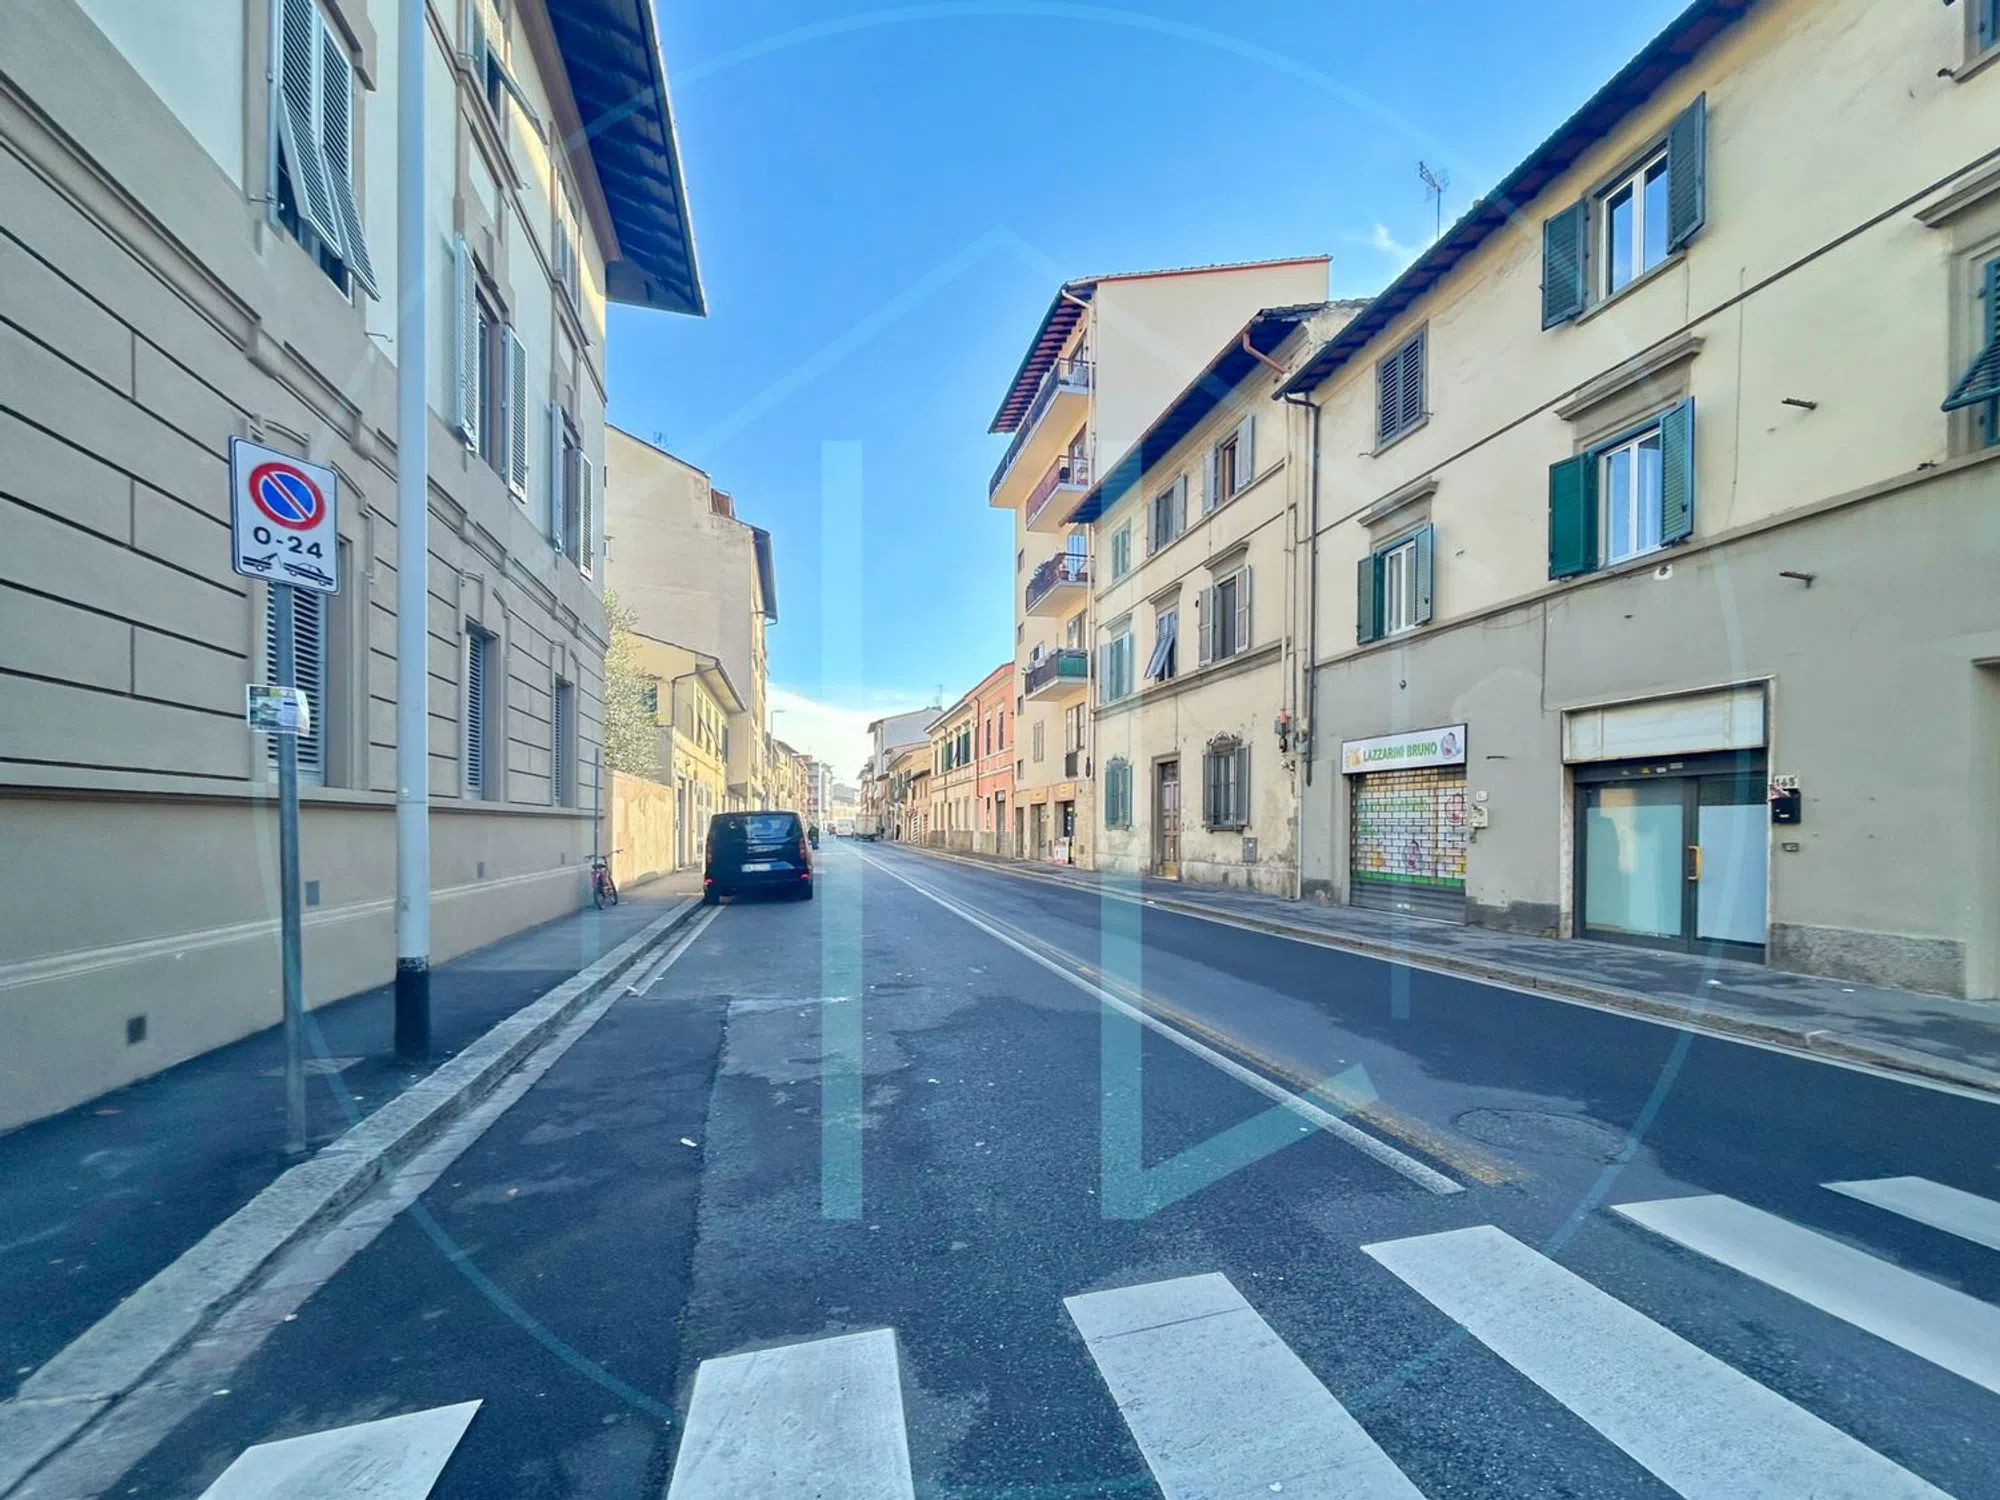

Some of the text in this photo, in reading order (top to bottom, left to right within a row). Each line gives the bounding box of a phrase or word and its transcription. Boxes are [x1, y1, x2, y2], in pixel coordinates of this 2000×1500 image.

[253, 526, 323, 559] 0-24
[1363, 741, 1438, 761] LAZZARINI BRUNO
